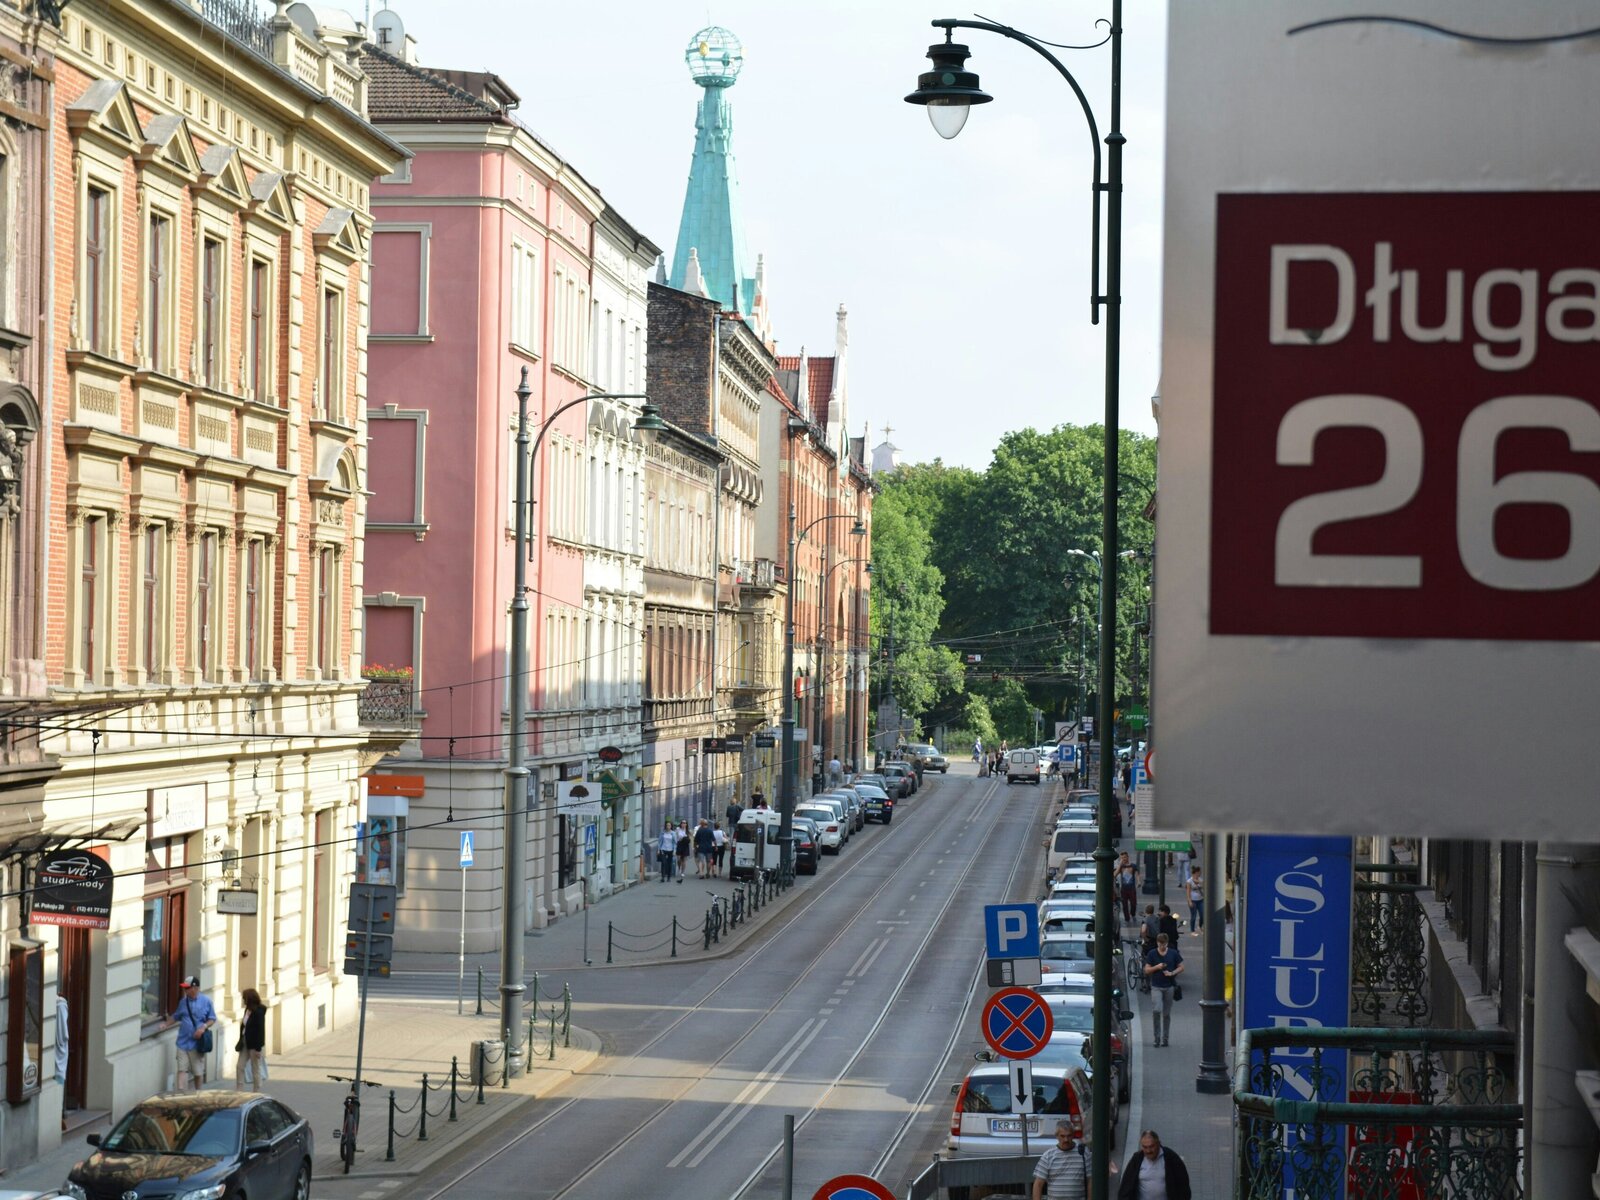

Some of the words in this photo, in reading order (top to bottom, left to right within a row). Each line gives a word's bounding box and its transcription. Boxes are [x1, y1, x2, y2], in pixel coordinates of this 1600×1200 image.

[1269, 241, 1600, 372] Długa
[1274, 394, 1600, 591] 26
[33, 914, 108, 928] www.evita.com.pl
[997, 910, 1028, 952] P
[1013, 1121, 1037, 1130] 13TU
